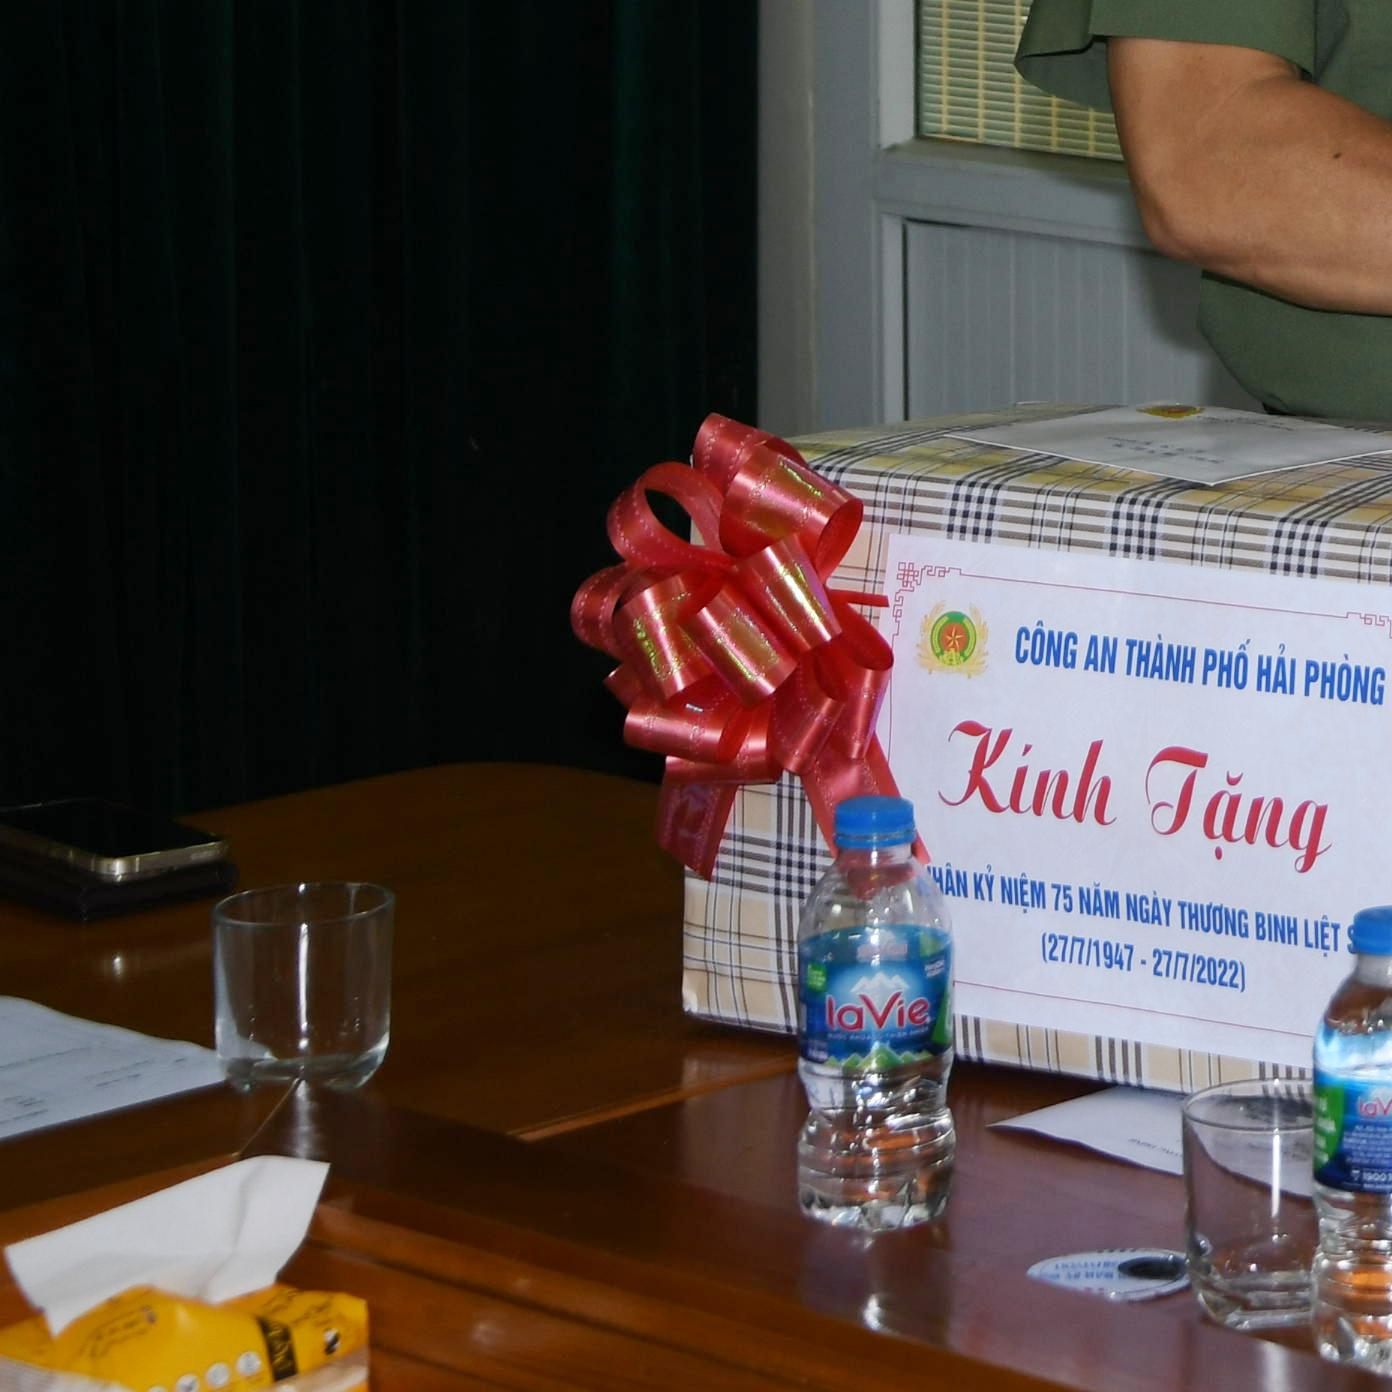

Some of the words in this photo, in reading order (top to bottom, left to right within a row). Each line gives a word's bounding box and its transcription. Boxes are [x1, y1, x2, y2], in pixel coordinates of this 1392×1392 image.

[1015, 620, 1078, 669] CÔNG
[1083, 634, 1118, 674] AN
[1126, 634, 1196, 684] THÀNH
[1202, 639, 1251, 690] PHỐ
[1256, 643, 1296, 695] HẢI
[1304, 654, 1386, 706] PHÒNG
[938, 720, 1117, 826] Kính
[1145, 746, 1332, 874] Tặng
[973, 864, 994, 902] KỶ
[1000, 872, 1046, 914] NIỆM
[1051, 883, 1073, 913] 75
[1078, 882, 1121, 919] NĂM
[1126, 890, 1172, 927] NGÀY
[1177, 900, 1249, 939] THƯƠNG
[1255, 911, 1298, 946] BINH
[1304, 915, 1341, 957] LIỆT
[1042, 932, 1134, 972] (27/7/1947
[1153, 948, 1245, 993] 27/7/2022)
[826, 990, 930, 1032] laVie
